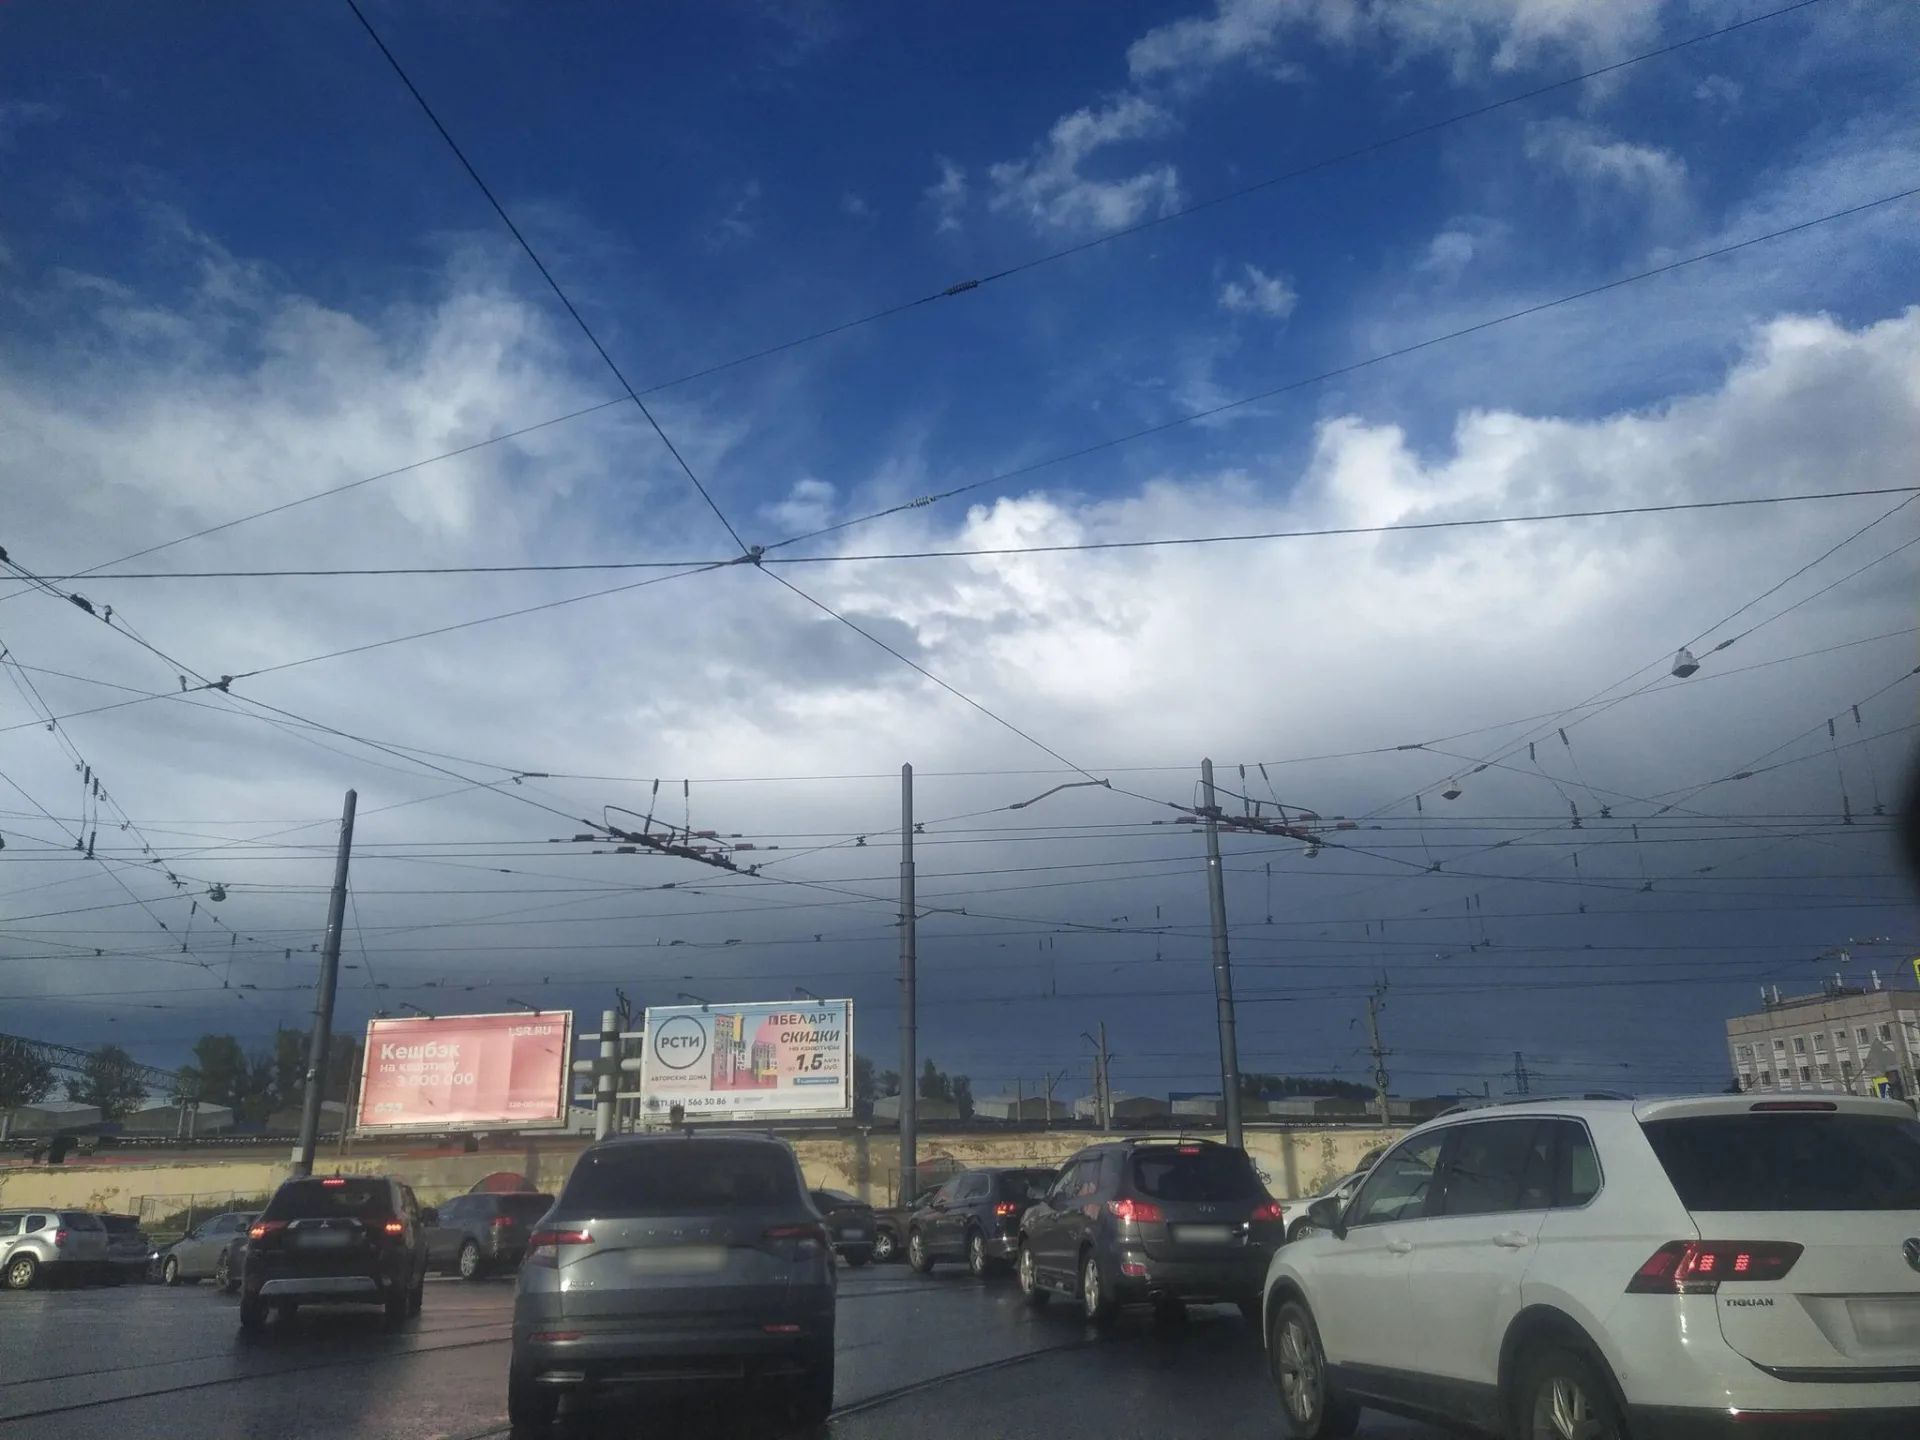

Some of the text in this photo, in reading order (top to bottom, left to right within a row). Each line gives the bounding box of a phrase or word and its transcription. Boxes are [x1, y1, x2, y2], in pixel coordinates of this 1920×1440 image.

[779, 1013, 837, 1026] БЕЛАРТ
[508, 1025, 552, 1037] LSR.RU
[780, 1029, 841, 1044] СКИДКИ
[661, 1035, 700, 1049] РСТИ
[380, 1040, 461, 1060] Кешбэк
[380, 1063, 396, 1073] на
[796, 1053, 824, 1073] 1,5
[396, 1075, 405, 1088] 3
[409, 1073, 440, 1087] 000
[443, 1071, 475, 1086] 000
[687, 1098, 703, 1107] 566
[704, 1097, 715, 1106] 30
[716, 1097, 728, 1106] 86
